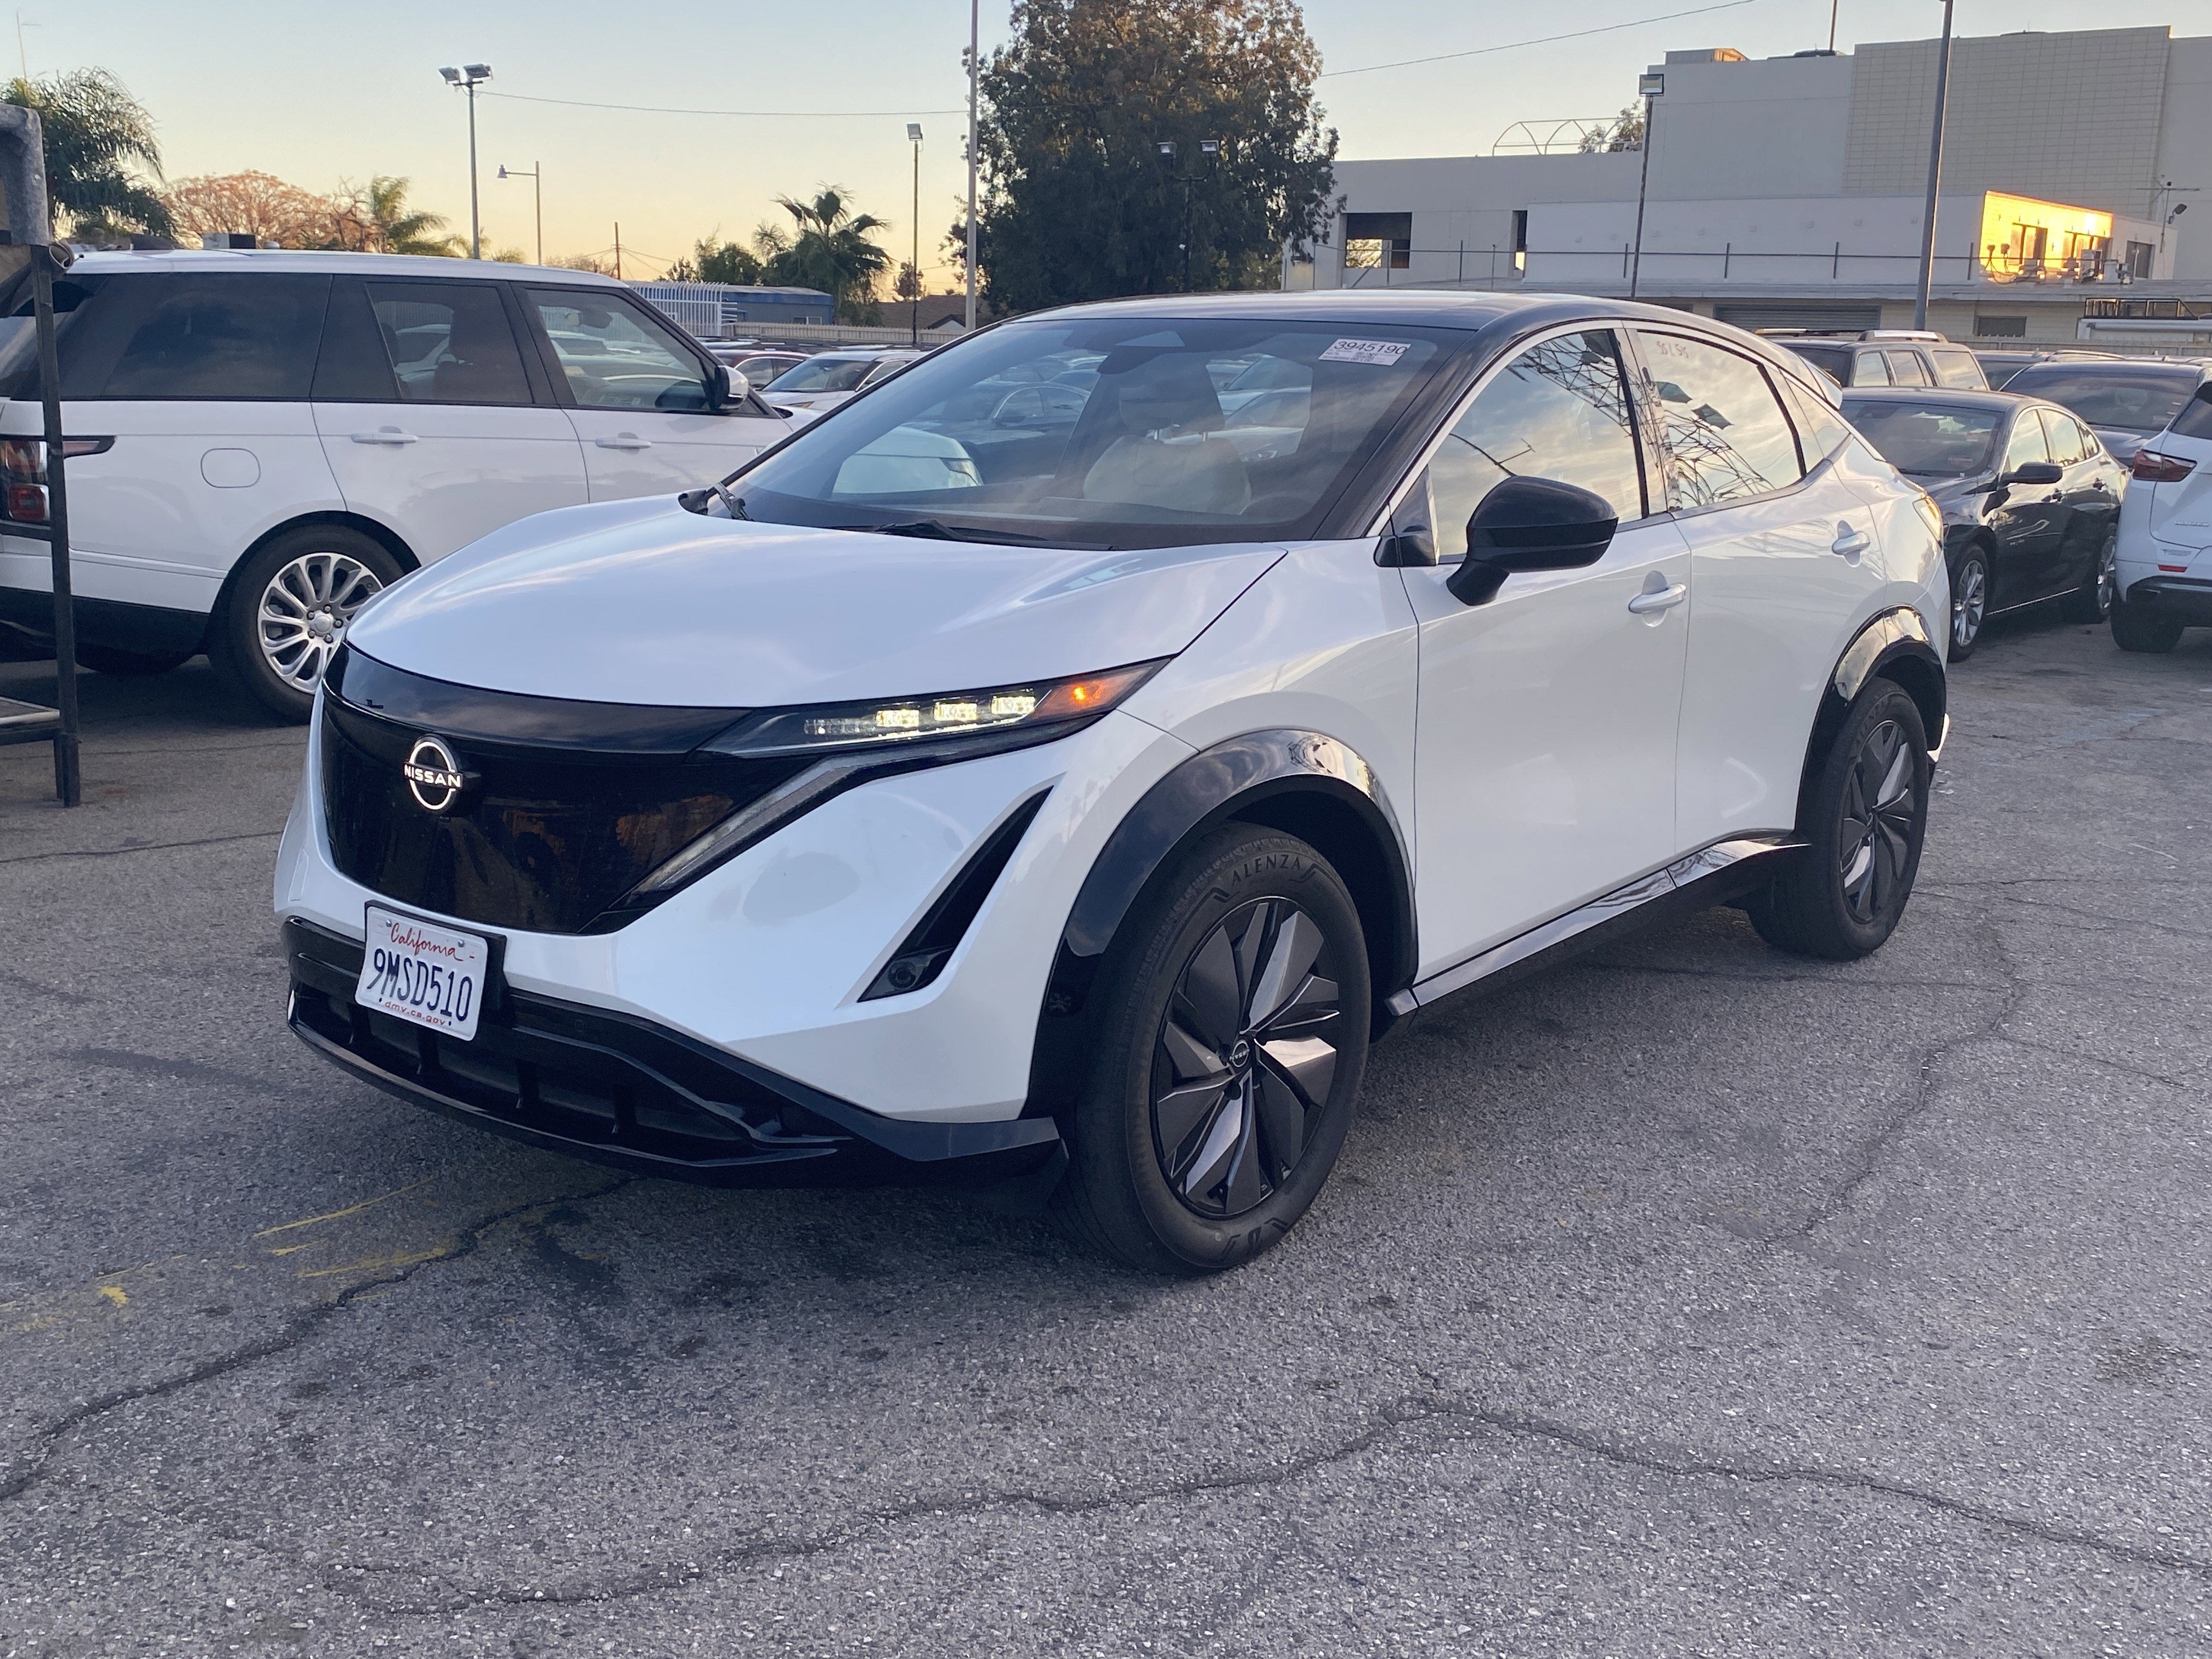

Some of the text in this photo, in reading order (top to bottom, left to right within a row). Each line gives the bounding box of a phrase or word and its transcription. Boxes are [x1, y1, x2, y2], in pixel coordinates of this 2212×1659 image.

[1334, 341, 1408, 354] 3945190
[404, 764, 461, 787] NISSAN
[1232, 854, 1302, 885] ALENZA
[390, 922, 464, 961] California
[367, 948, 473, 1022] 9MSD510
[385, 1001, 446, 1026] dmv.ca.gov
